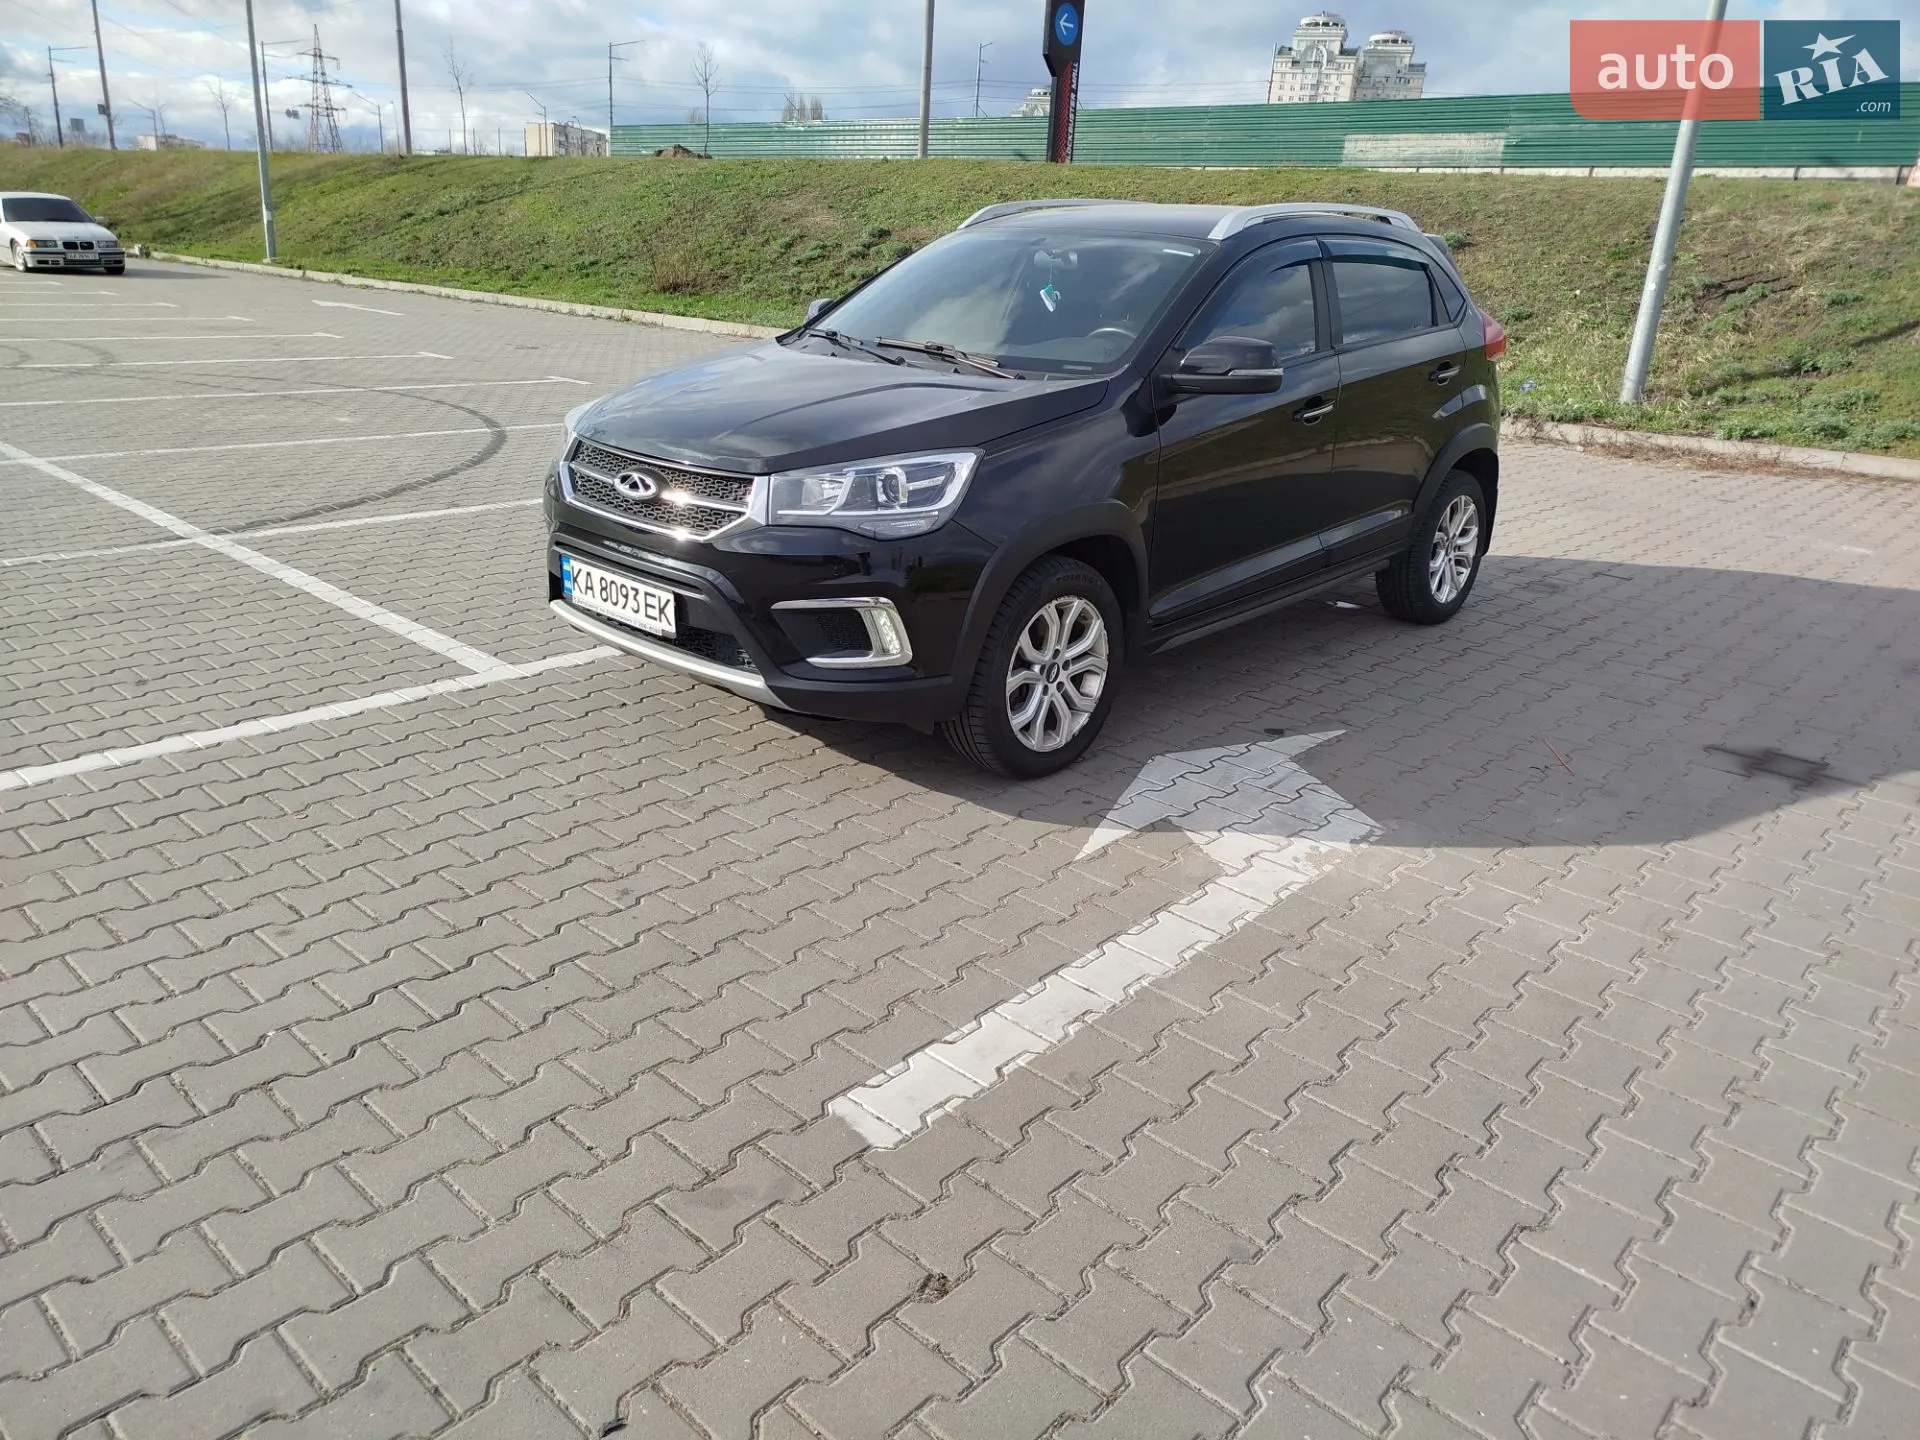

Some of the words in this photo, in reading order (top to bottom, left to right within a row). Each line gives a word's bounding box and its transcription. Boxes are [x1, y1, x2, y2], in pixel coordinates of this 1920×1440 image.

[572, 565, 595, 599] KA
[600, 576, 640, 614] 8093
[644, 590, 672, 627] EK
